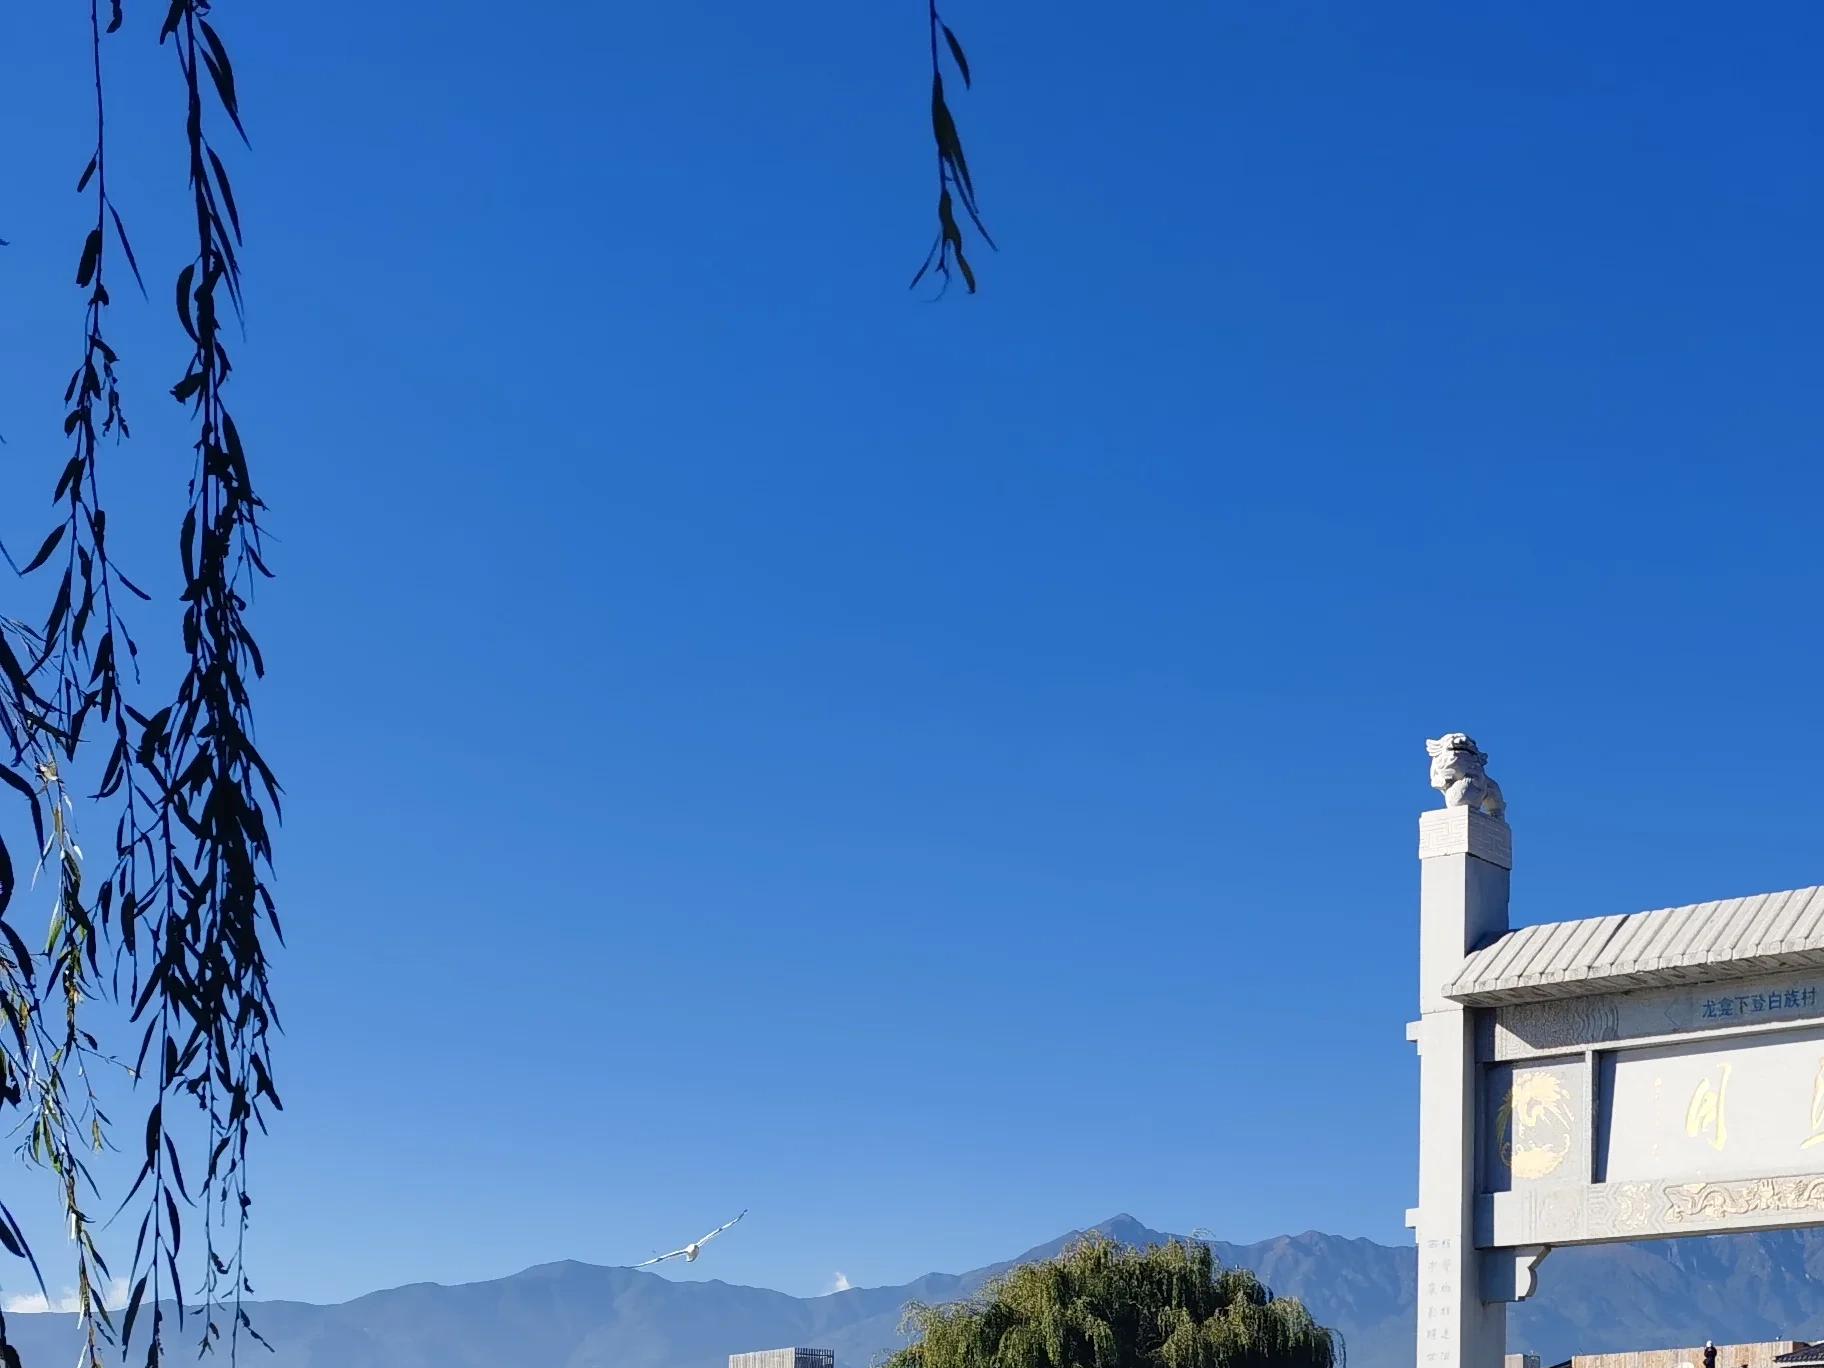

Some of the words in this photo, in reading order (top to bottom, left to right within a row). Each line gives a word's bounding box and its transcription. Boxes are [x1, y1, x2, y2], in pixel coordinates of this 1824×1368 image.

[1702, 987, 1817, 1019] 龙龛下登白族村
